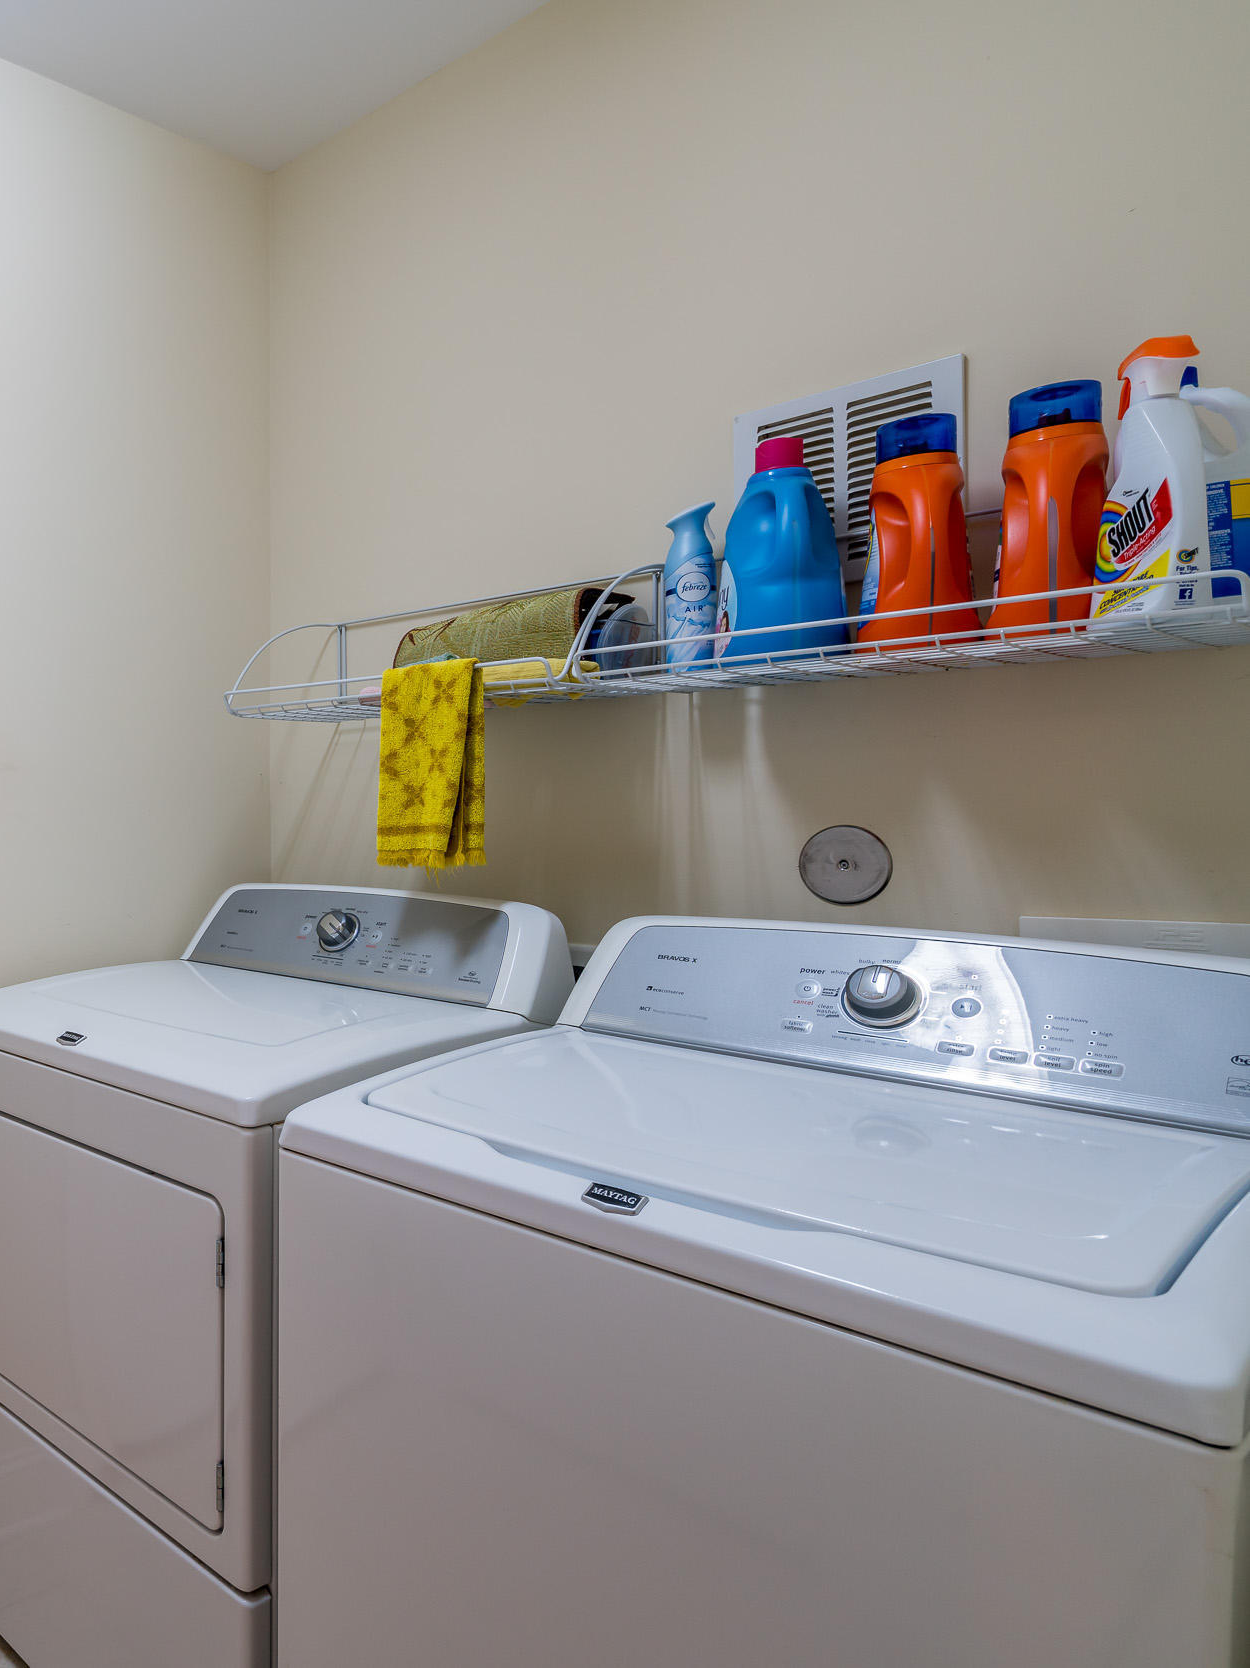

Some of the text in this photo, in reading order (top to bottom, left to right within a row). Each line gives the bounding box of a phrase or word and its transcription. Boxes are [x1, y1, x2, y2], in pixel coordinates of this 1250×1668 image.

[1107, 487, 1153, 558] SHOUT
[1123, 525, 1156, 560] Triple-Acting
[681, 582, 708, 594] febreze
[684, 604, 704, 613] AIR
[657, 954, 690, 962] BRAVOS
[799, 967, 827, 975] power
[1090, 1067, 1113, 1075] speed
[591, 1186, 637, 1205] MAYTAG
